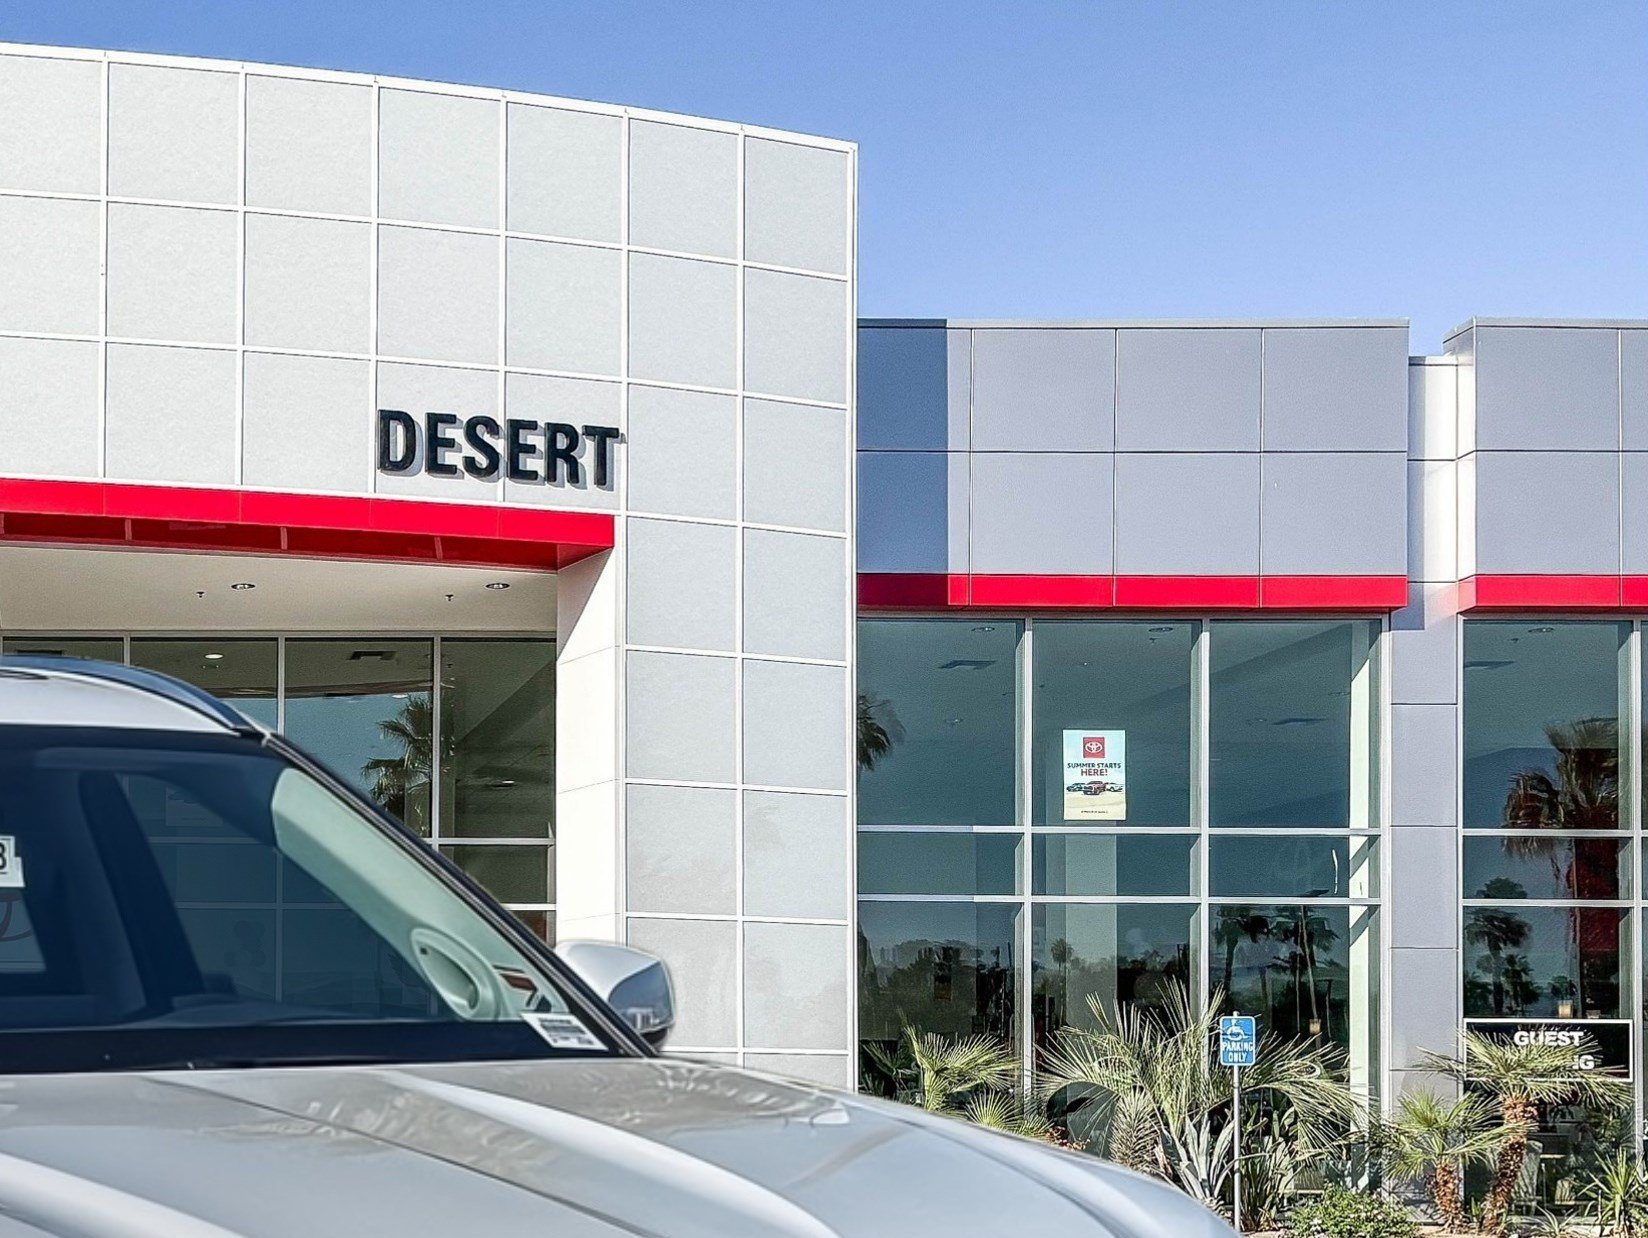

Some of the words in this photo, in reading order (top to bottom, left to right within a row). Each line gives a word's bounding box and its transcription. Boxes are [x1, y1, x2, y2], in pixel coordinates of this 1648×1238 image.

[377, 409, 620, 487] DESERT
[1080, 768, 1108, 776] HERE!
[1513, 1031, 1585, 1047] GUEST
[1222, 1041, 1253, 1052] PARKING
[1228, 1052, 1248, 1062] ONLY
